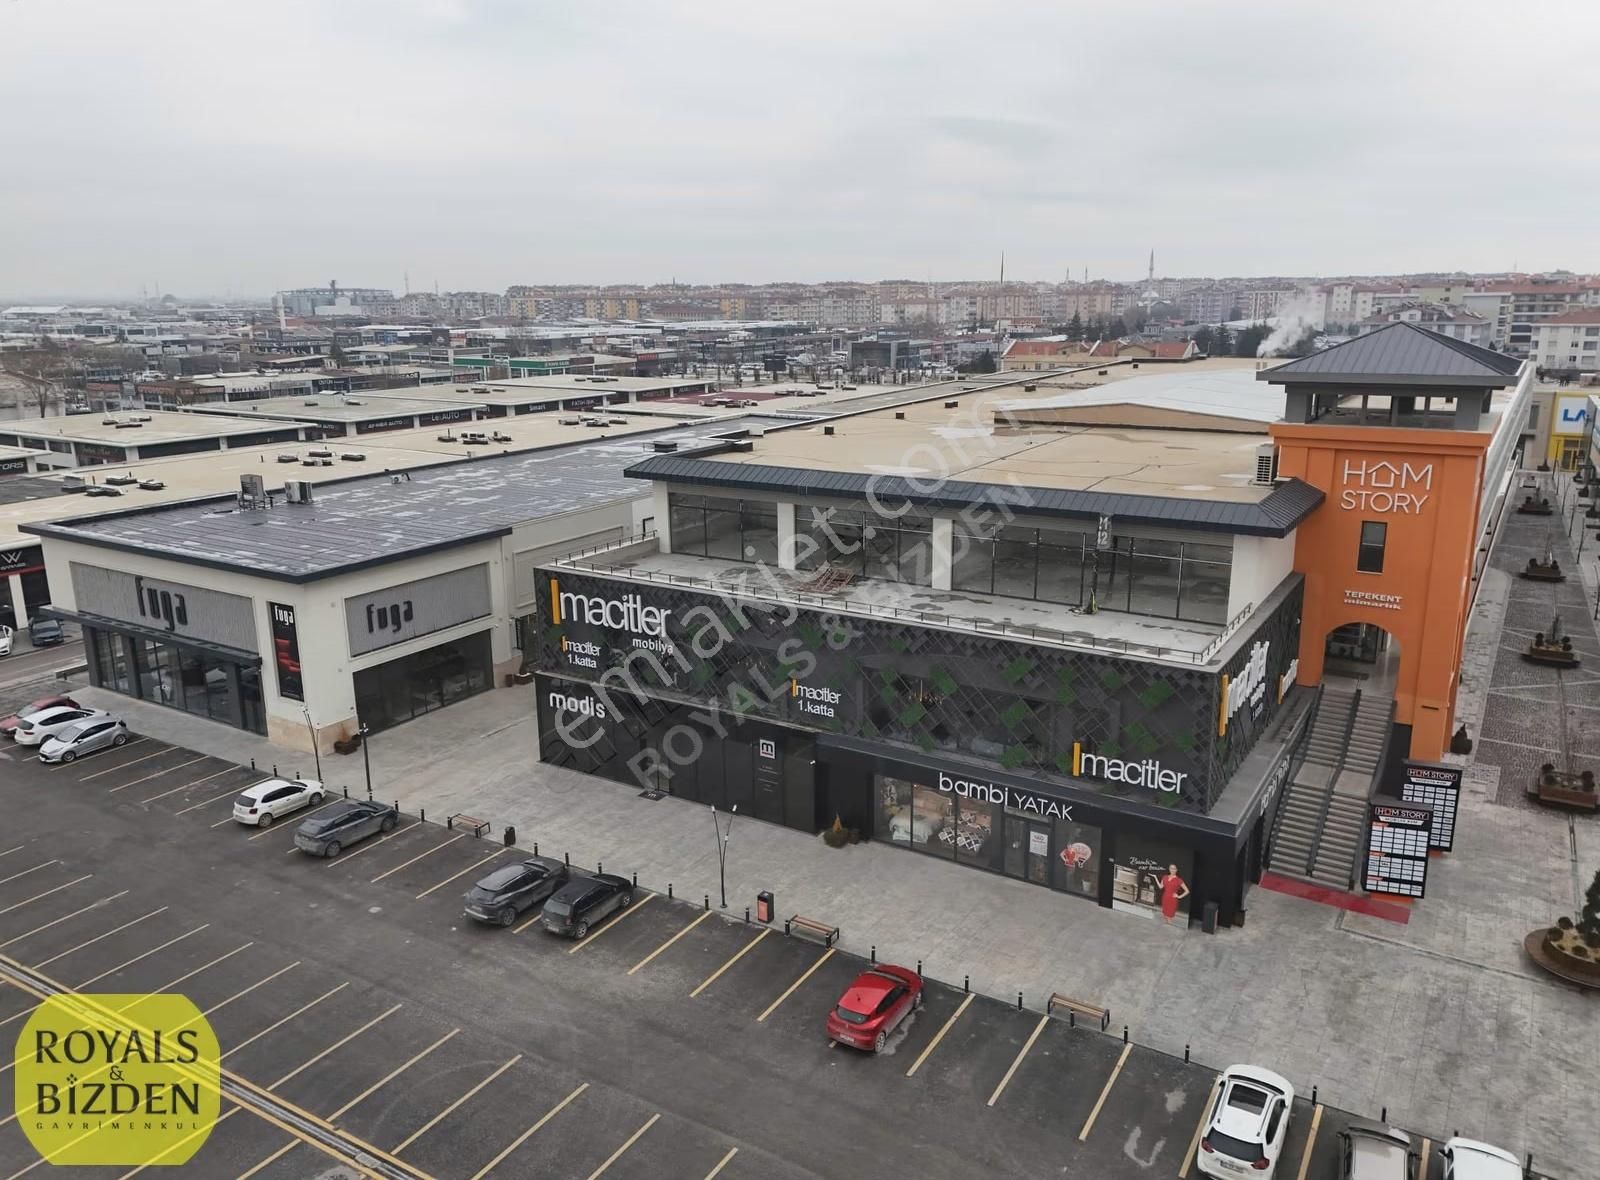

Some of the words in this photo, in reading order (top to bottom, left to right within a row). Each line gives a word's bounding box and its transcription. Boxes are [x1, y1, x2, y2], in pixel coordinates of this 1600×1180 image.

[0, 461, 25, 471] ORS
[1340, 489, 1430, 515] STORY
[135, 575, 189, 632] fuga
[1344, 590, 1403, 603] TEPEKENT
[274, 605, 294, 626] fuga
[366, 600, 414, 634] fuga
[559, 590, 672, 637] macitler
[564, 638, 601, 657] macitler
[632, 637, 674, 654] mobilya
[567, 653, 597, 668] 1.katta
[795, 684, 841, 704] macitler
[549, 692, 606, 718] modis
[797, 700, 834, 718] 1.katta
[1080, 751, 1188, 794] macitler
[939, 772, 1009, 806] bambi
[1014, 792, 1073, 821] YATAK
